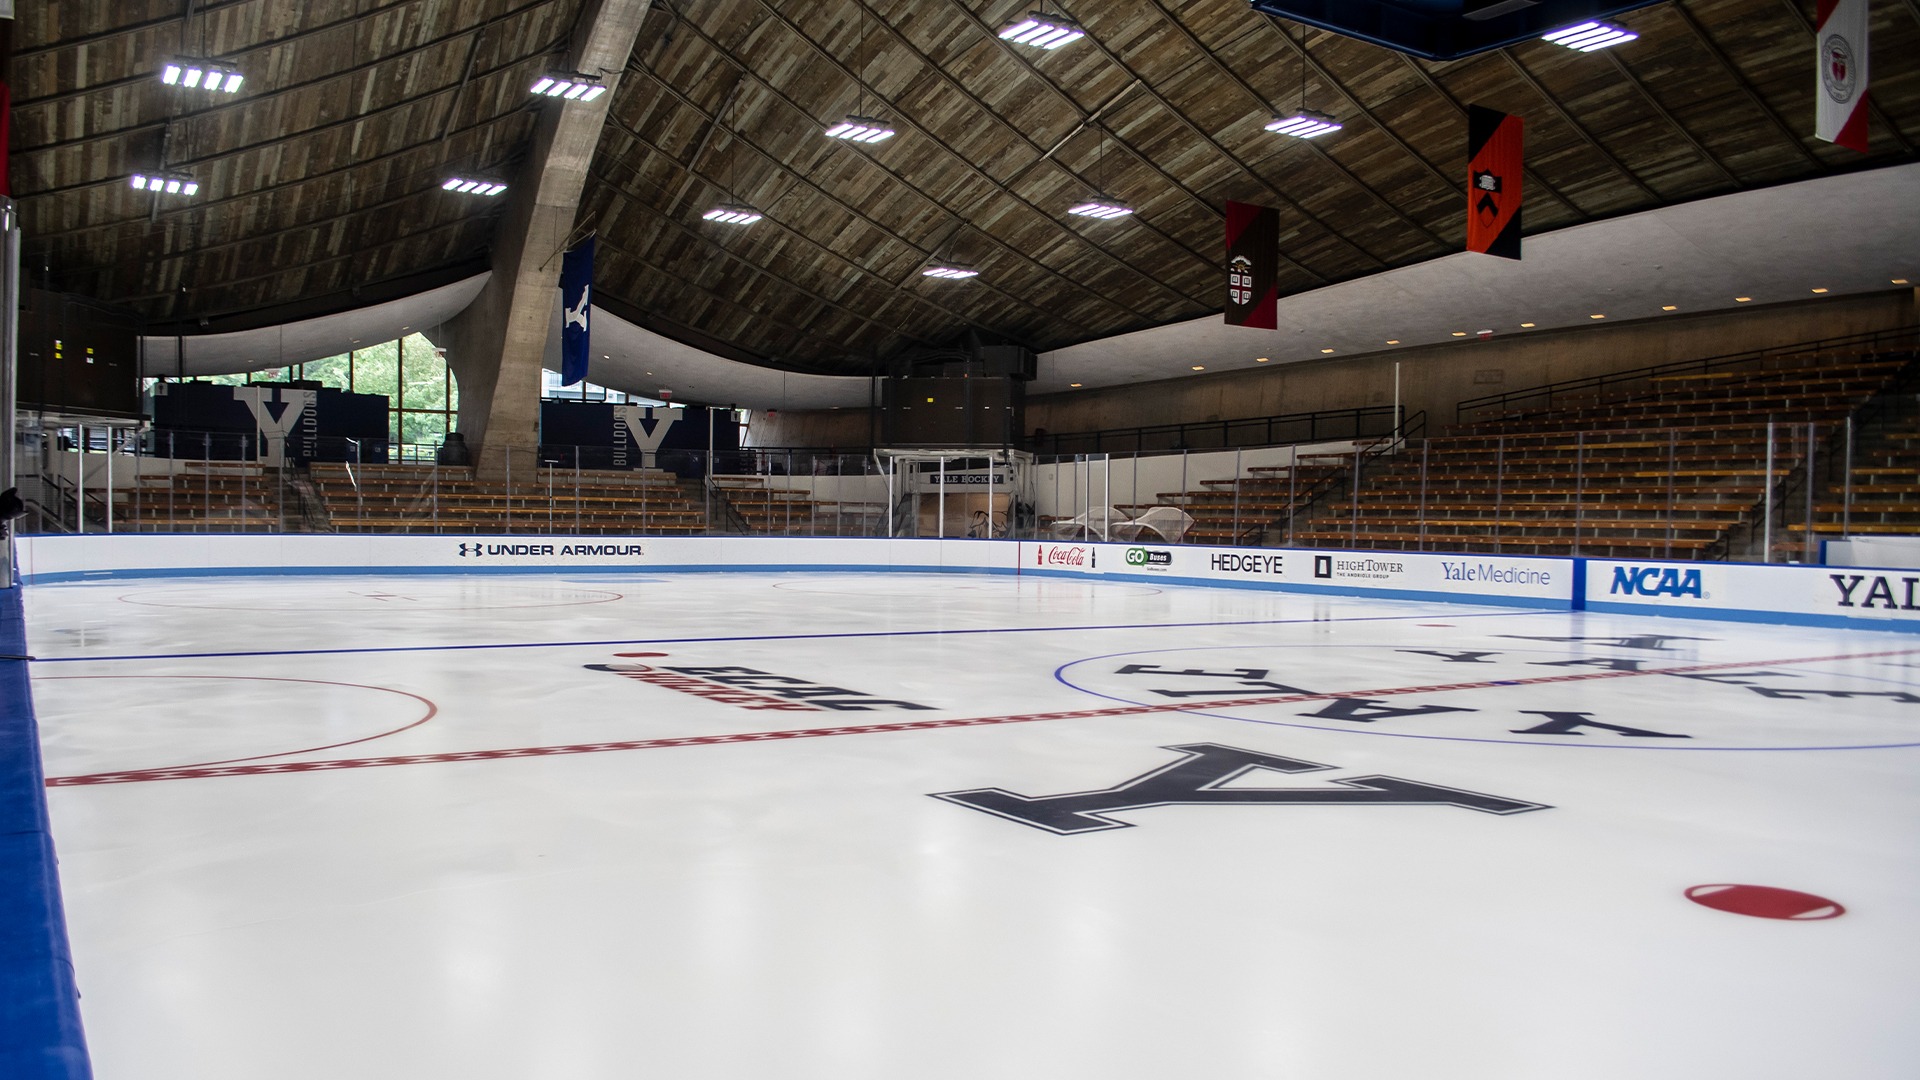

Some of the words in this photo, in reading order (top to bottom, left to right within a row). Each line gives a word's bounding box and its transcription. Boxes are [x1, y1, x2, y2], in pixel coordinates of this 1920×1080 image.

[565, 284, 589, 331] Y
[233, 386, 317, 467] Y
[613, 405, 683, 472] Y
[487, 544, 554, 556] UNDER
[560, 544, 642, 556] ARMOUR
[1127, 549, 1145, 563] GO
[1149, 553, 1167, 561] Buses
[1211, 553, 1283, 574] HEDGEYE
[1441, 561, 1476, 582] Yale
[1478, 563, 1551, 585] Medicine
[1610, 566, 1702, 599] NCAA
[614, 672, 826, 712] HOCKEY
[656, 665, 942, 711] ECAC
[927, 741, 1556, 836] Y
